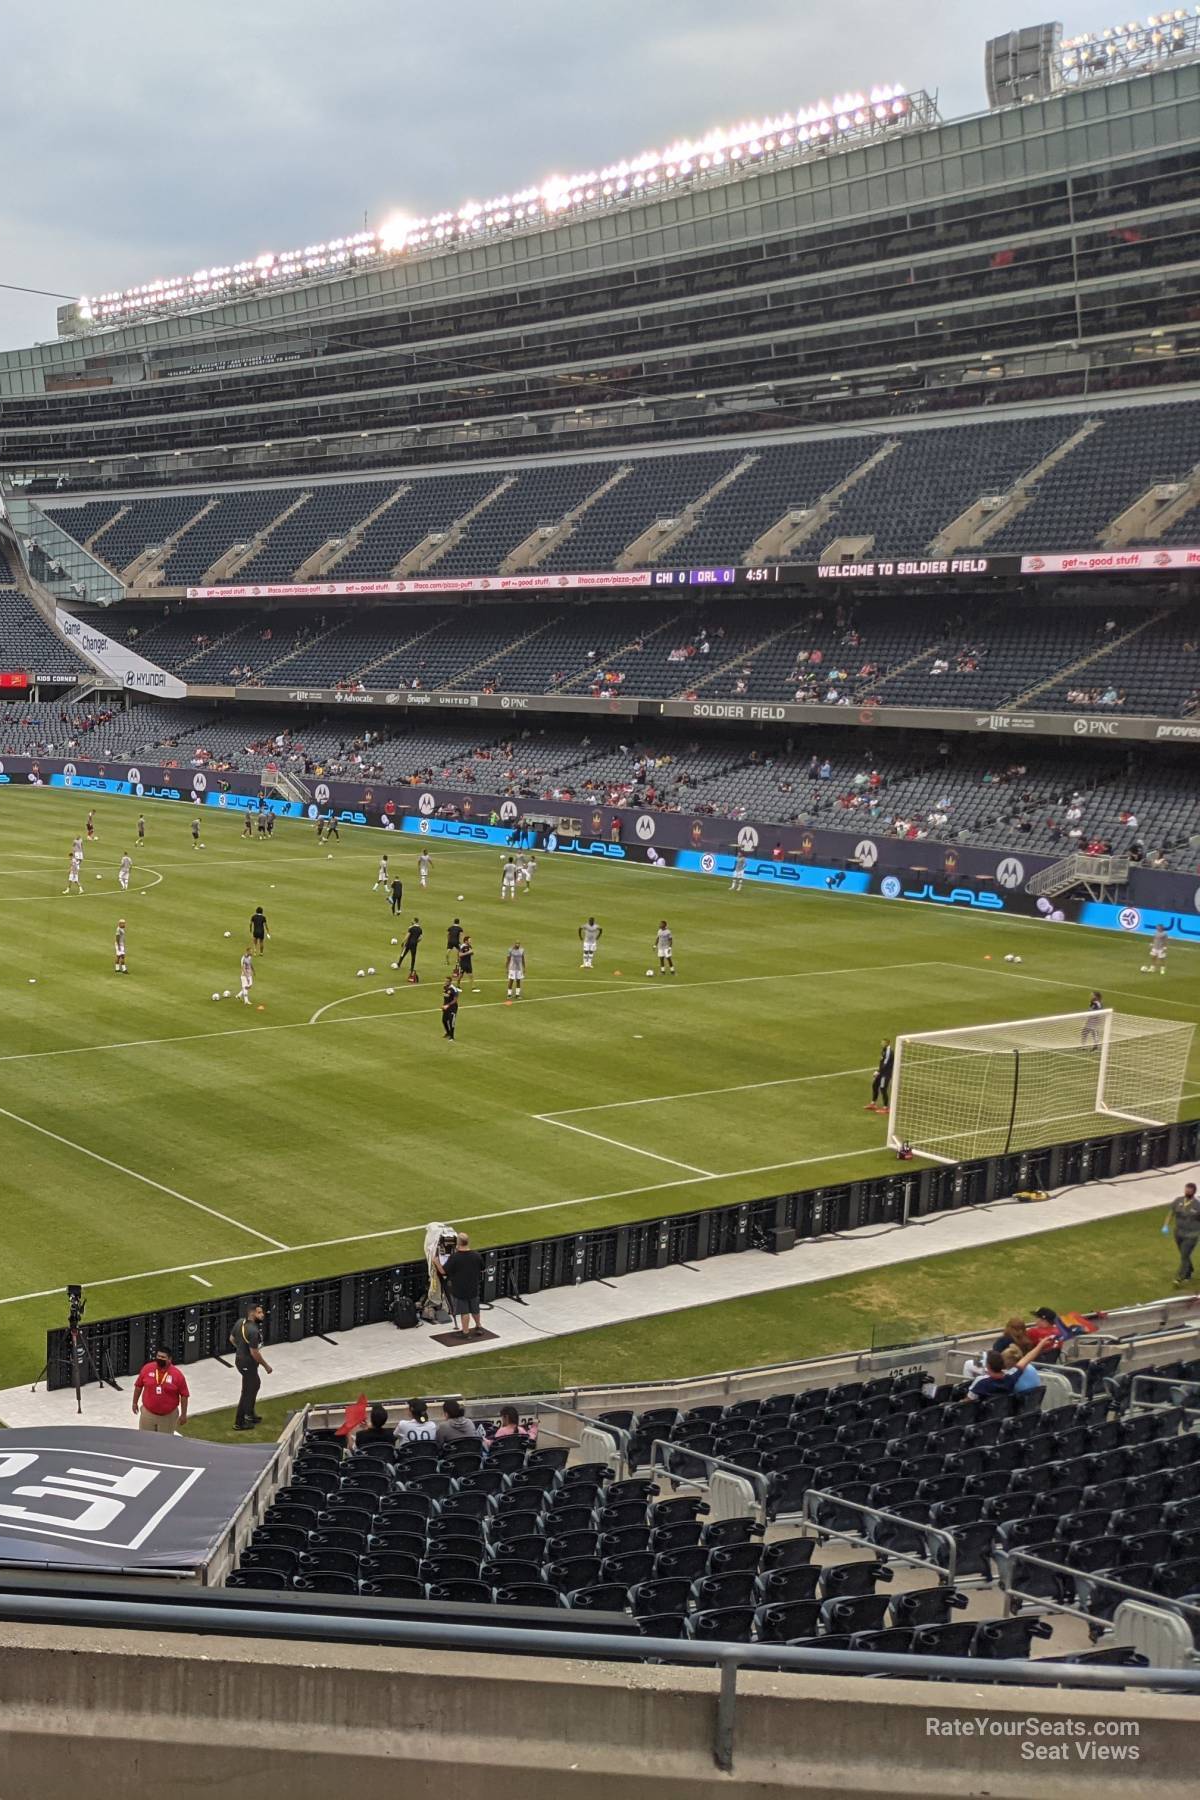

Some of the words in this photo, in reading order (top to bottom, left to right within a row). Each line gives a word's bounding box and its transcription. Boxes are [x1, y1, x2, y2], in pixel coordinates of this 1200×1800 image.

[1062, 557, 1078, 568] get
[1089, 556, 1113, 568] good
[818, 564, 874, 578] WELCOME
[878, 563, 893, 575] TO
[897, 561, 948, 575] SOLDIER
[951, 559, 987, 573] FIELD
[656, 572, 673, 584] CHI
[679, 572, 685, 583] 0
[698, 571, 717, 582] ORL
[723, 571, 729, 581] 0
[746, 569, 768, 581] 4:51
[360, 584, 375, 592] good
[518, 579, 533, 587] good
[64, 621, 81, 635] Game
[82, 636, 109, 654] Changer.
[136, 674, 167, 687] HYUNDAI
[343, 693, 374, 703] Advocate
[406, 694, 431, 704] Snapple
[439, 697, 469, 705] UNITED
[510, 699, 529, 708] PNC
[693, 704, 744, 718] SOLDIER
[750, 706, 785, 719] FIELD
[989, 715, 1010, 730] Lite
[1089, 720, 1119, 735] PNC
[71, 779, 107, 790] JLAB
[144, 786, 180, 799] JLAB
[430, 823, 489, 840] JLAB
[558, 839, 626, 858] JLAB
[903, 884, 1004, 909] JLAB
